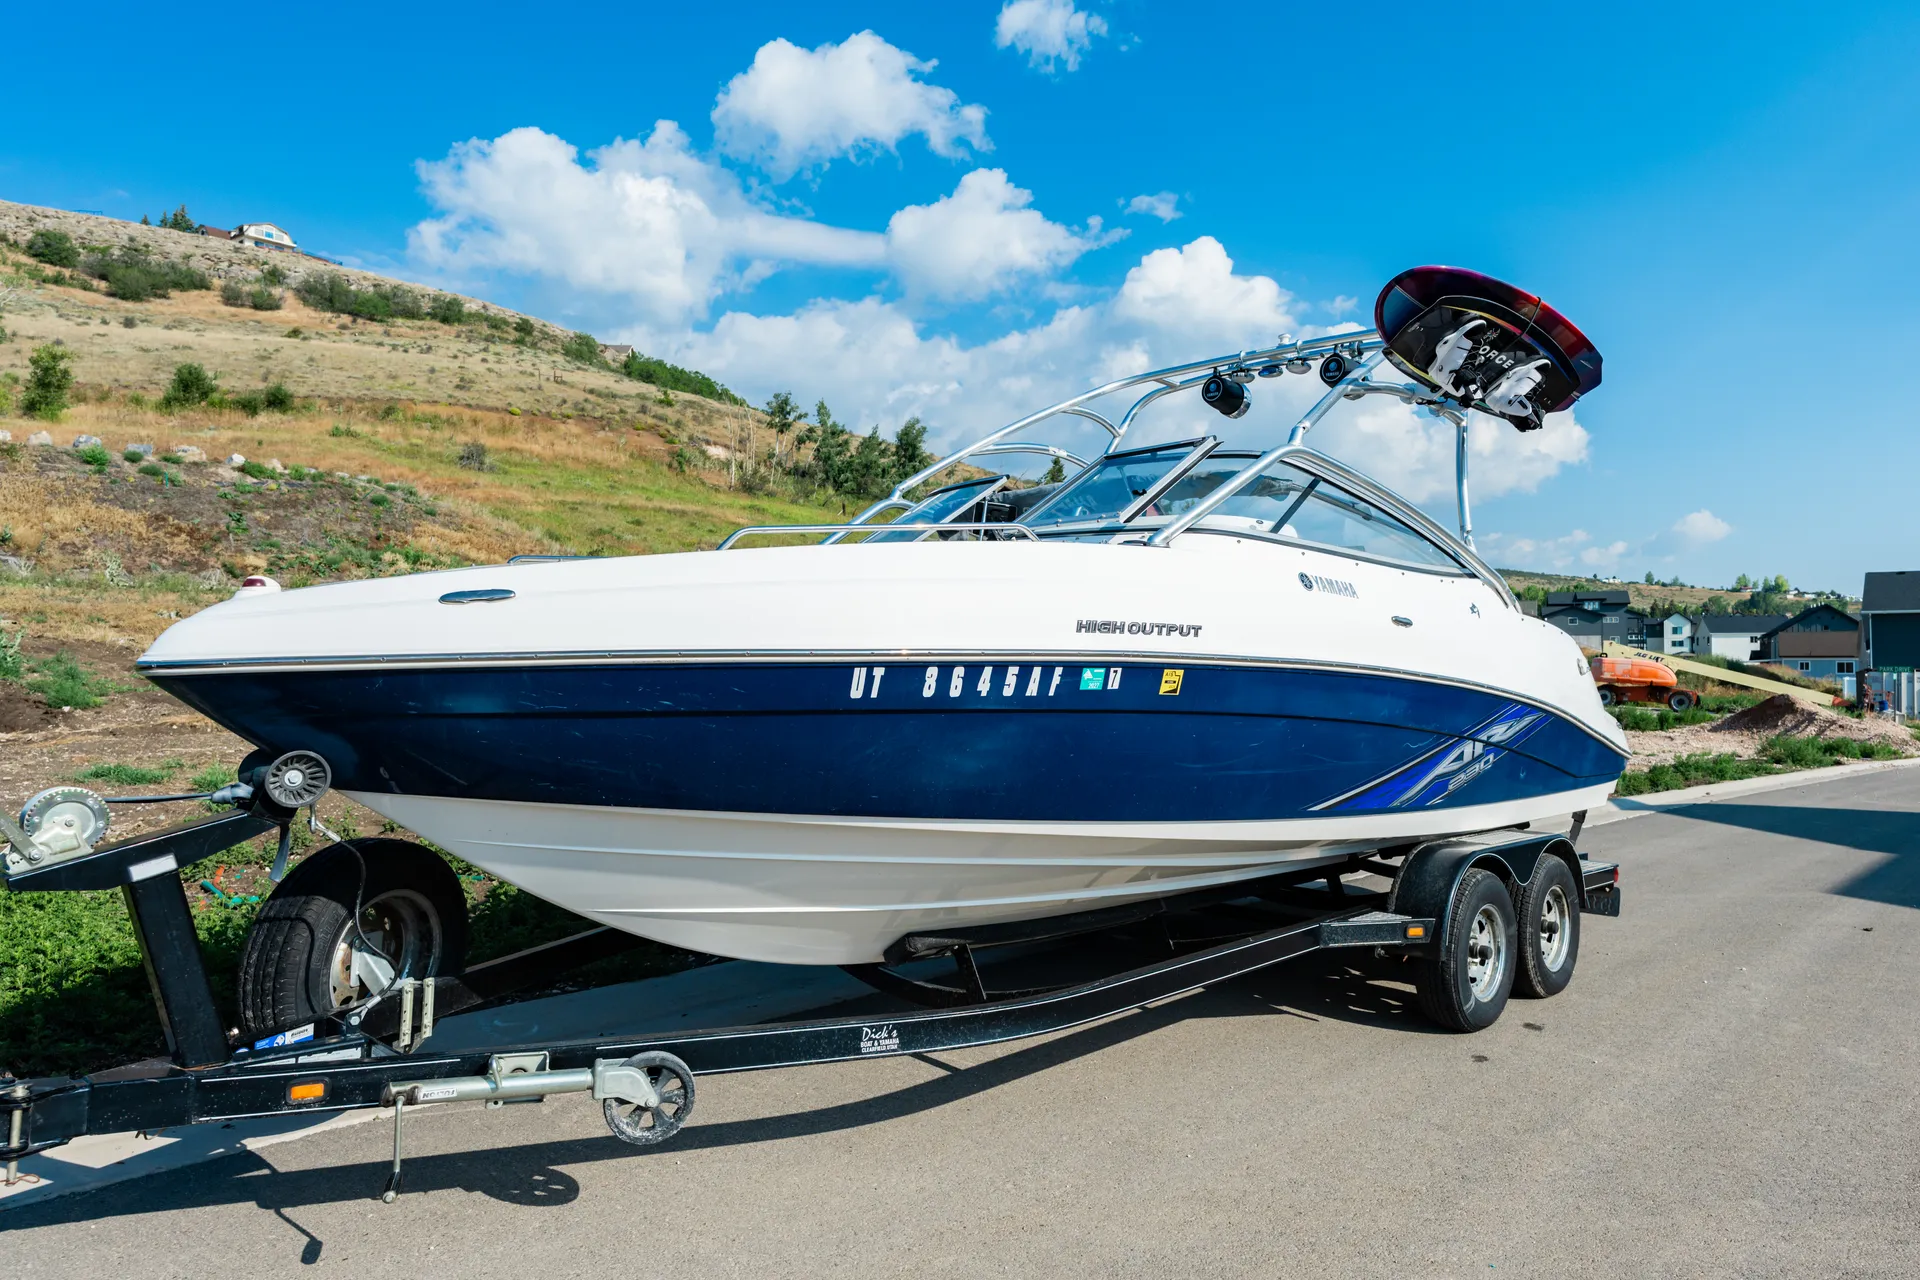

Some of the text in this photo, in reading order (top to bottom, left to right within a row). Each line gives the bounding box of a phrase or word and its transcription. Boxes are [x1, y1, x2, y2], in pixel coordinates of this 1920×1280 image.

[1479, 345, 1515, 369] ORCE
[1310, 574, 1360, 600] YAMAHA
[1076, 619, 1203, 638] HIGH OUTPUT
[849, 666, 886, 699] UT
[1447, 752, 1495, 792] 230
[863, 1024, 897, 1041] Dick's
